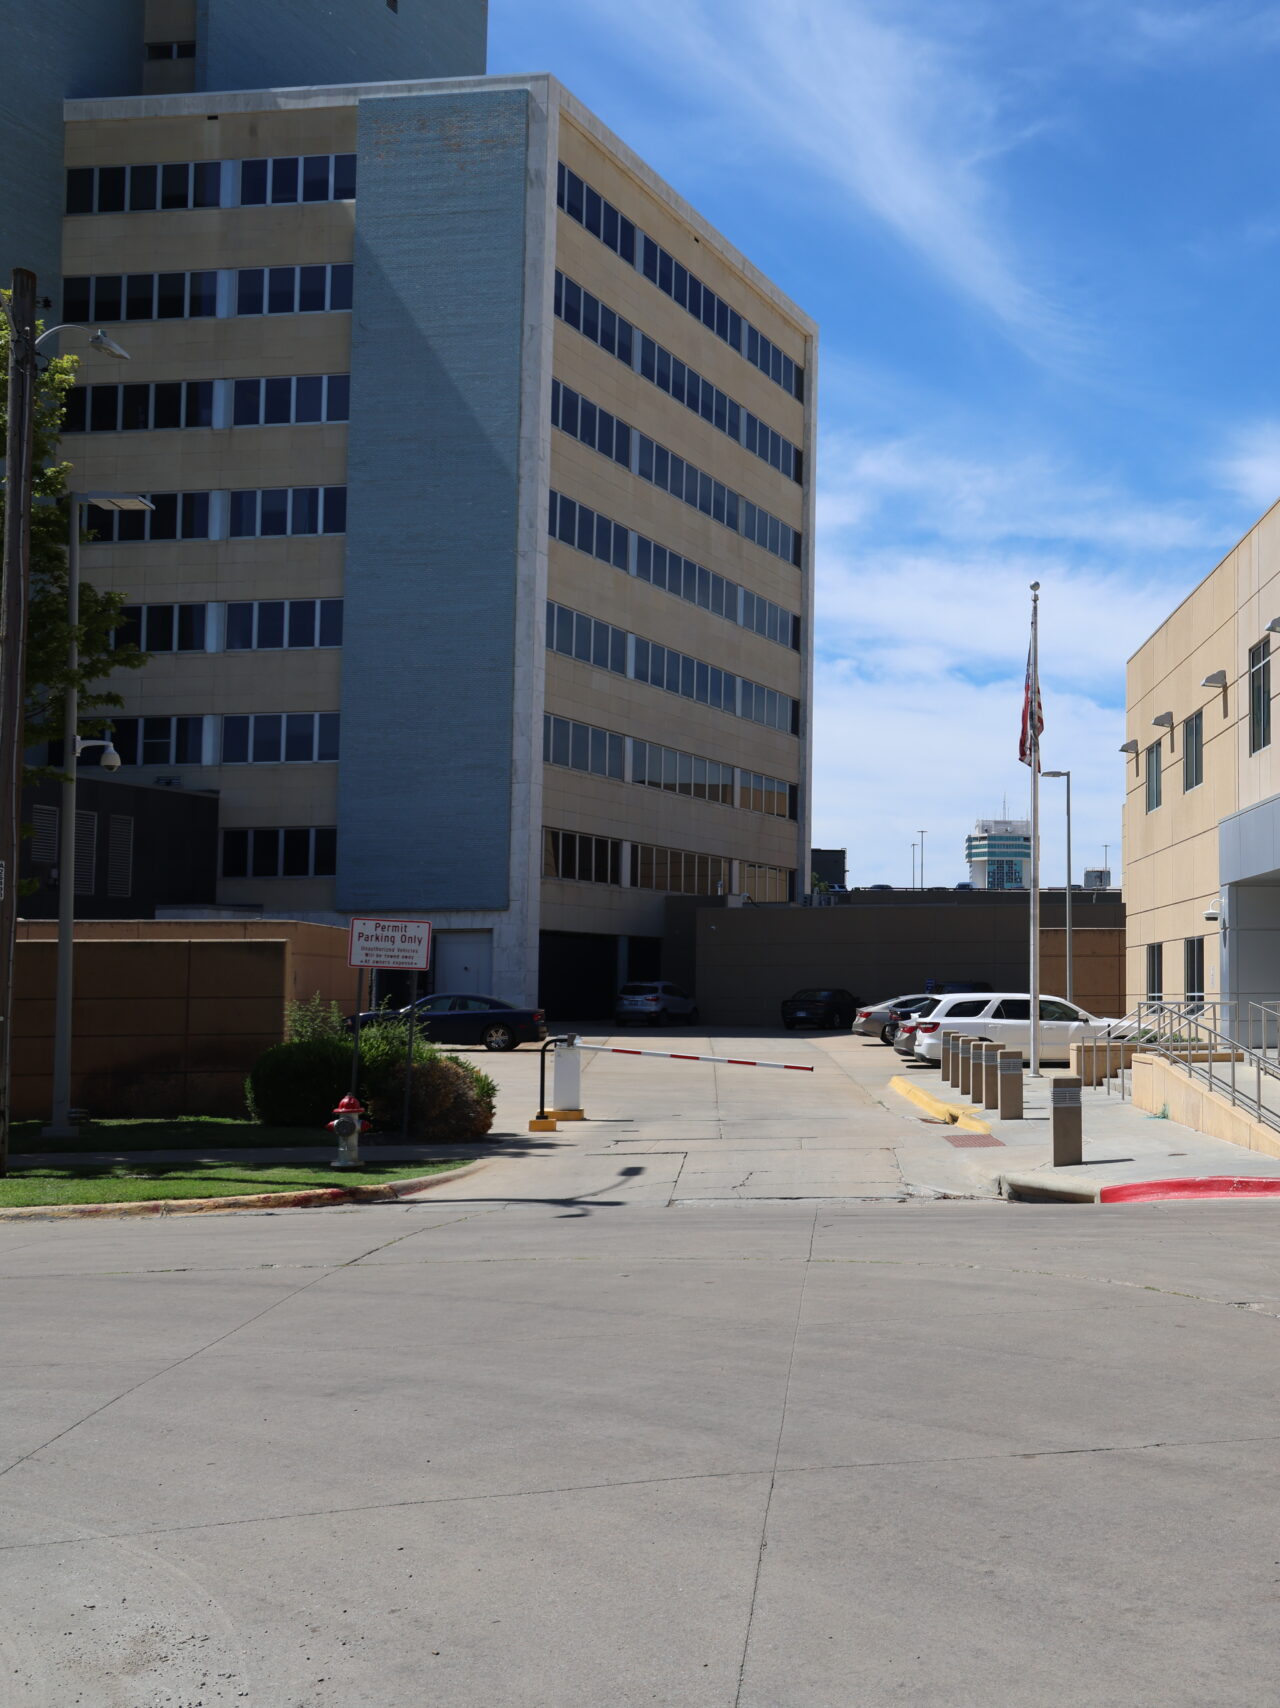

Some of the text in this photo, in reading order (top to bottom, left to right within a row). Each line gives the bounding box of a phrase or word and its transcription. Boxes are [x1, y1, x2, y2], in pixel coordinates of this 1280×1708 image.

[374, 922, 408, 933] Permit
[357, 932, 423, 946] Parking Only
